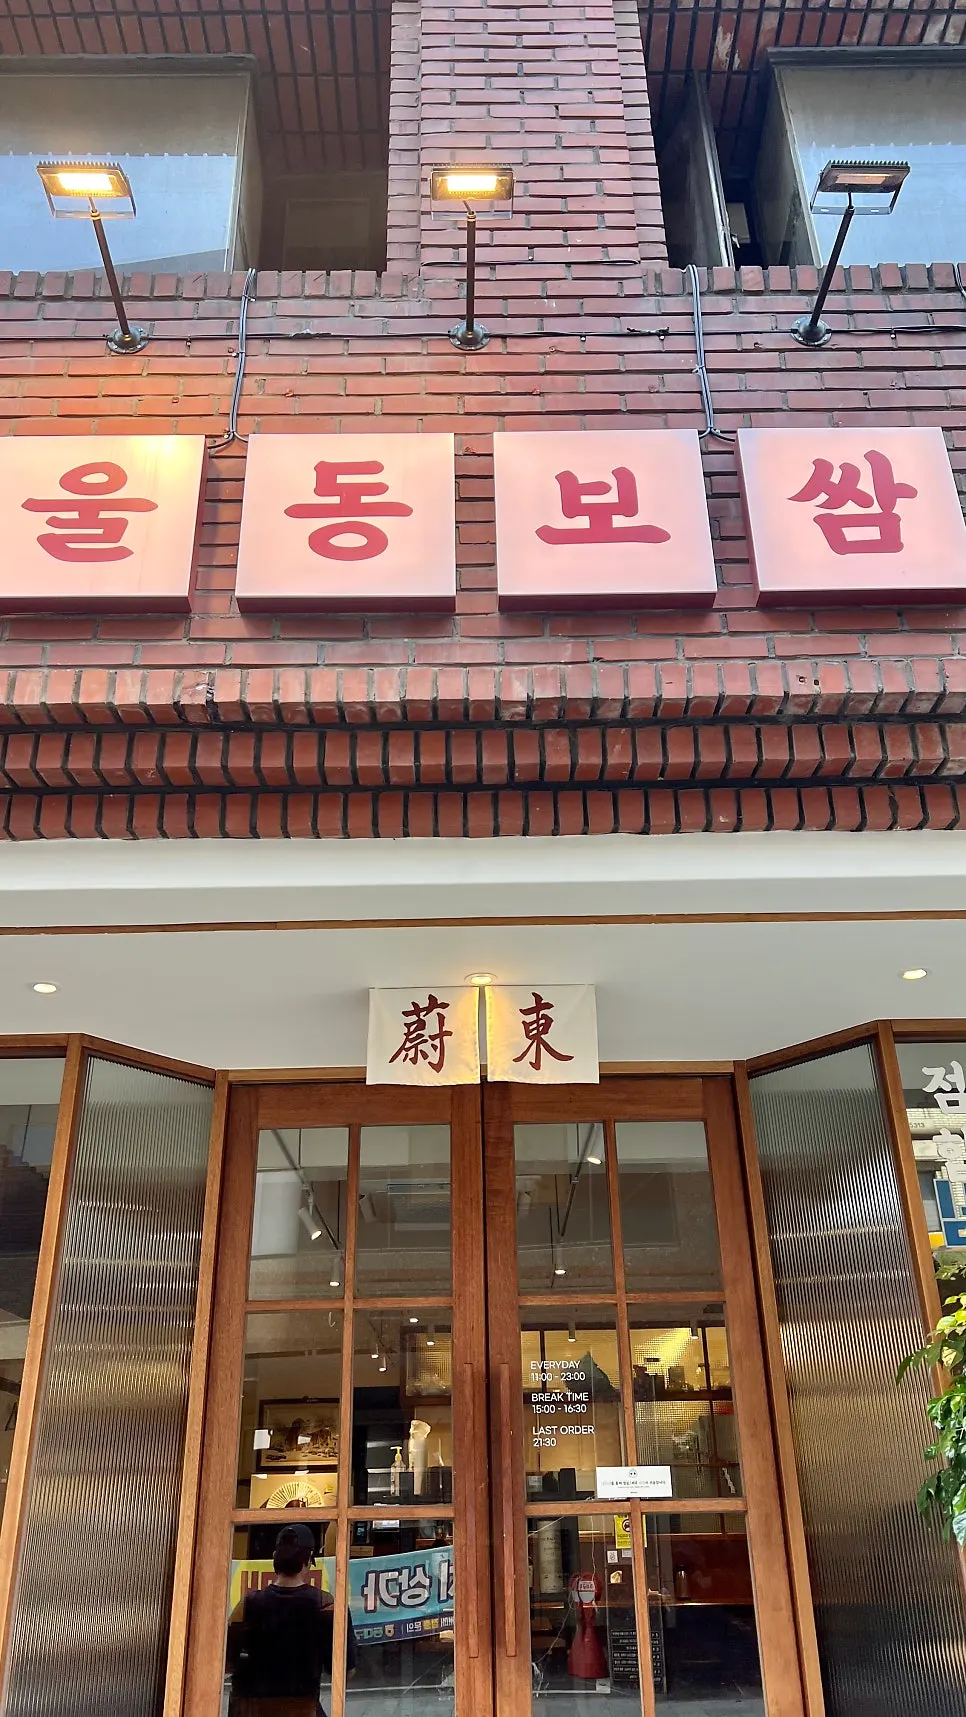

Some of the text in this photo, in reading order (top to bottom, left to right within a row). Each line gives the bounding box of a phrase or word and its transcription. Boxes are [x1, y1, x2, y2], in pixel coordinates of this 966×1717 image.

[530, 1360, 581, 1370] EVERYDAY
[530, 1372, 553, 1382] 11:00
[560, 1371, 586, 1382] 23:00
[531, 1392, 589, 1402] BREAK TIME
[532, 1404, 556, 1414] 15:00
[564, 1403, 587, 1413] 16:30
[532, 1425, 595, 1435] LAST ORDER
[533, 1437, 557, 1447] 21:30
